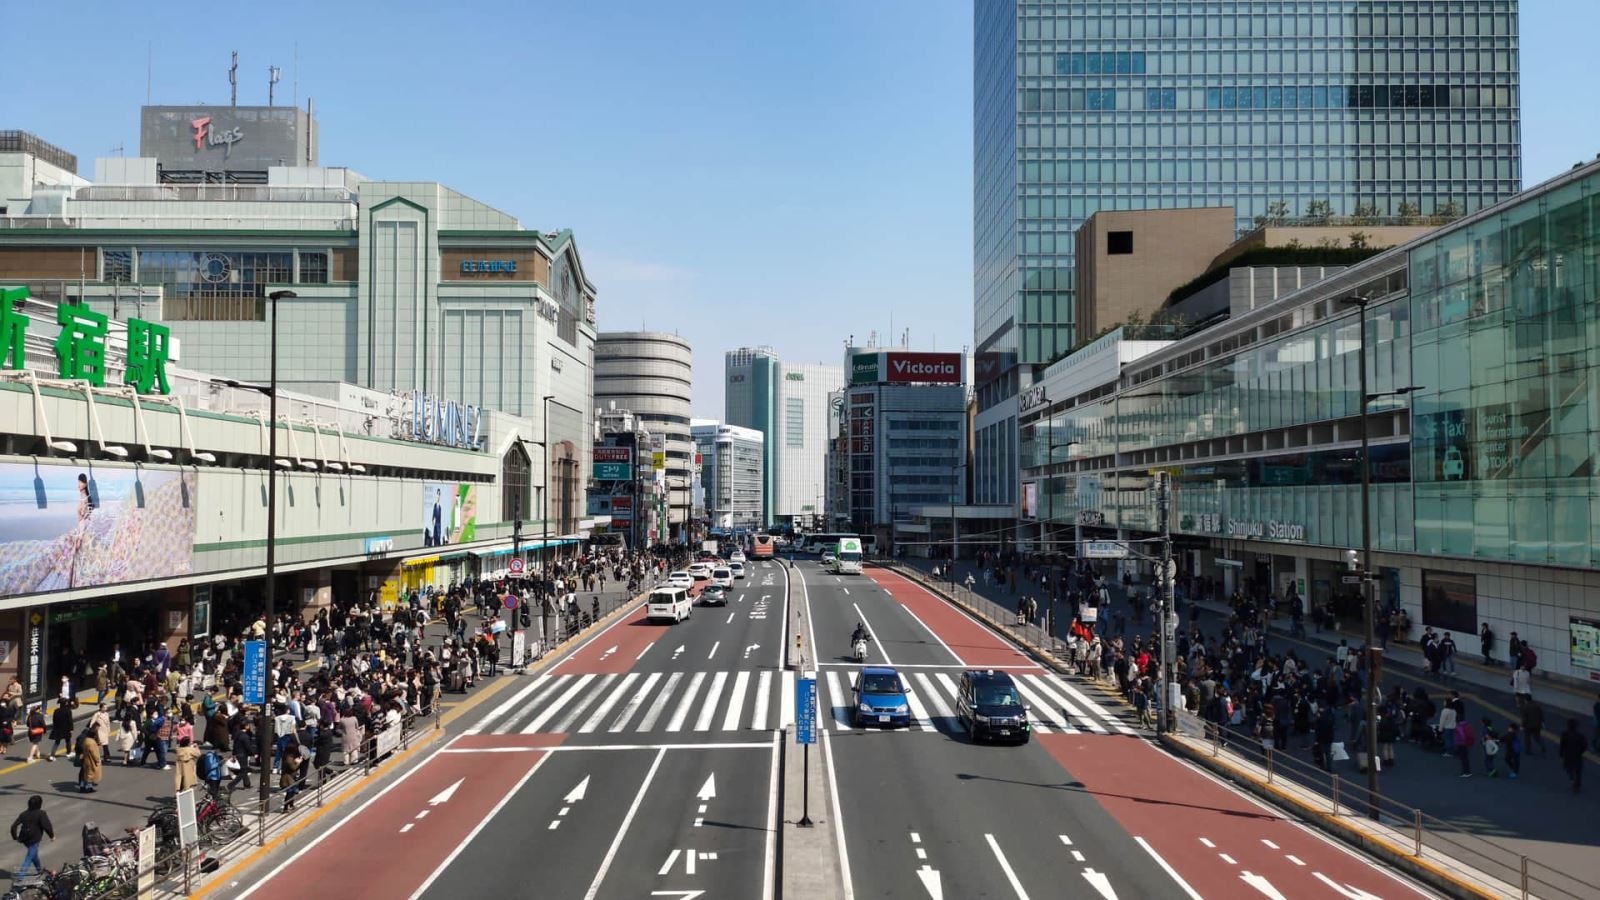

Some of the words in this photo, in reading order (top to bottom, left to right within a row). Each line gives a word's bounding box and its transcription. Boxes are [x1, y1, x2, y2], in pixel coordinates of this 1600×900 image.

[191, 116, 244, 157] Flags
[893, 360, 954, 374] Victoria
[863, 408, 873, 452] Victoria
[1442, 418, 1466, 437] Taxi
[1480, 425, 1529, 438] formation
[1481, 442, 1506, 452] enter
[602, 465, 619, 473] ニトリ
[1228, 518, 1263, 537] Shinjuku
[1269, 519, 1303, 540] Station
